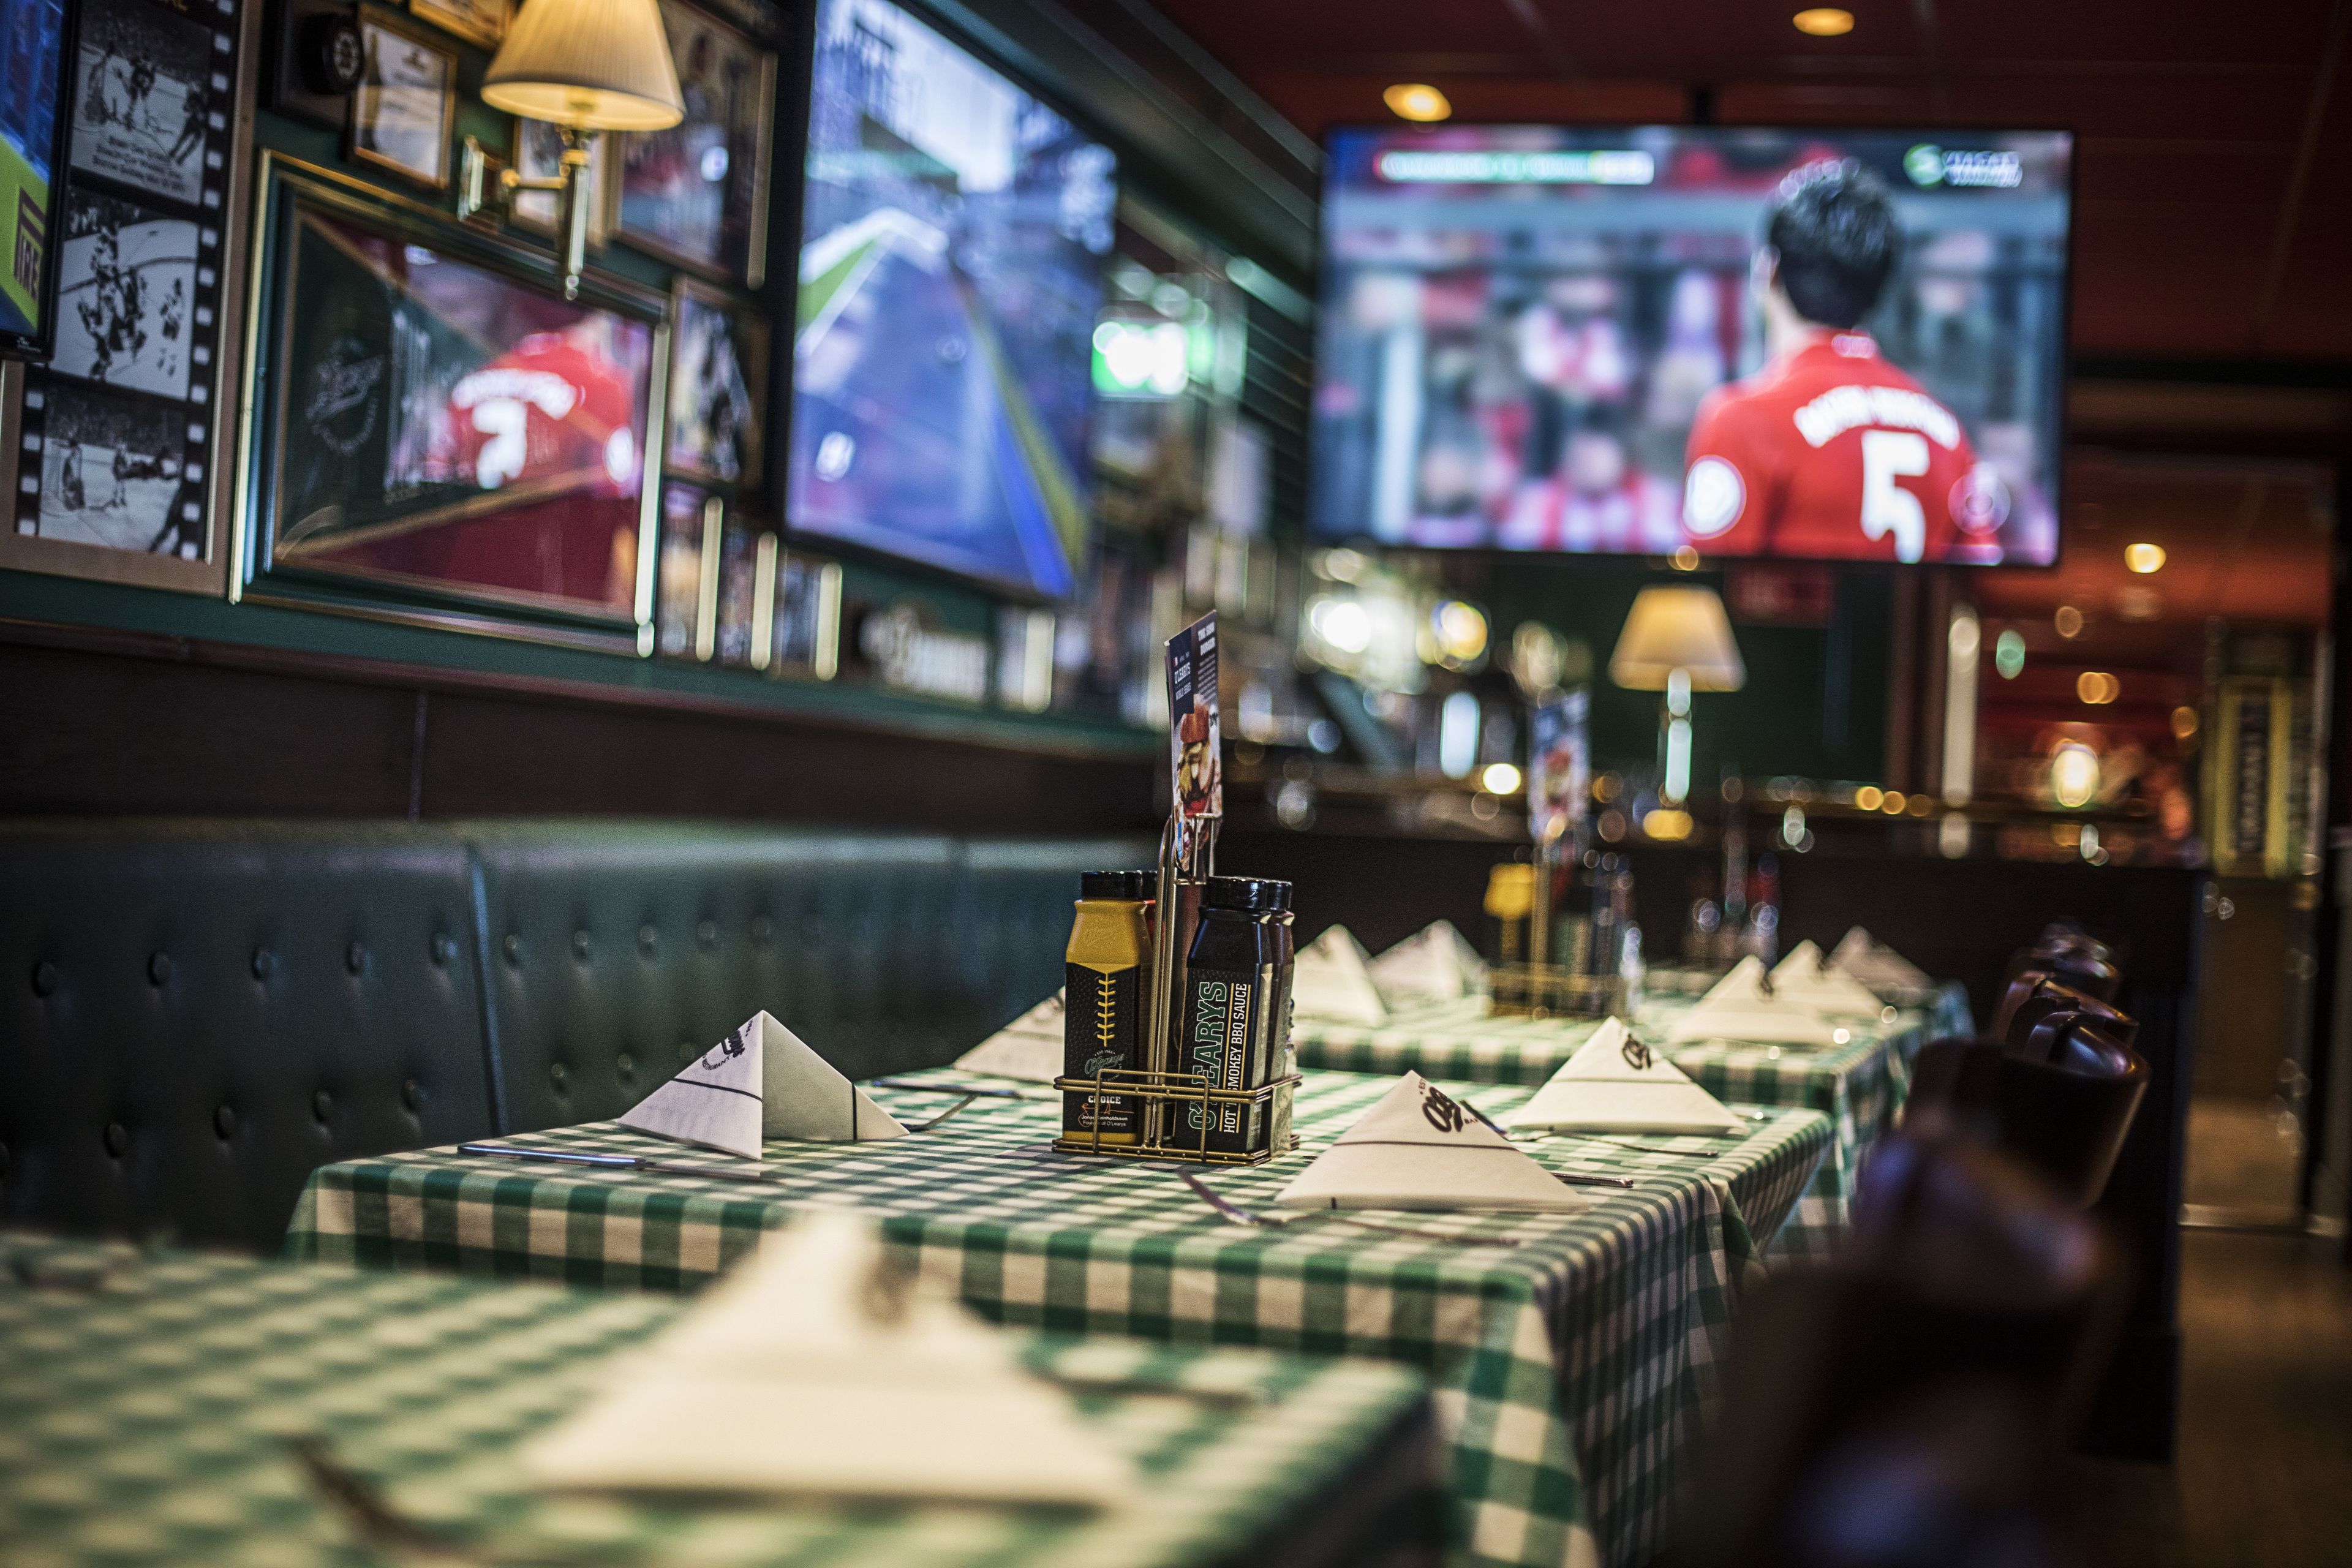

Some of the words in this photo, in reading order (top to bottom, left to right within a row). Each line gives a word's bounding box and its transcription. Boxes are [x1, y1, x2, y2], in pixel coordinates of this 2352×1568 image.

[1861, 429, 1930, 564] 5
[1234, 983, 1247, 1019] SAUCE
[1231, 1022, 1246, 1045] BBQ
[1224, 1110, 1236, 1133] HOT
